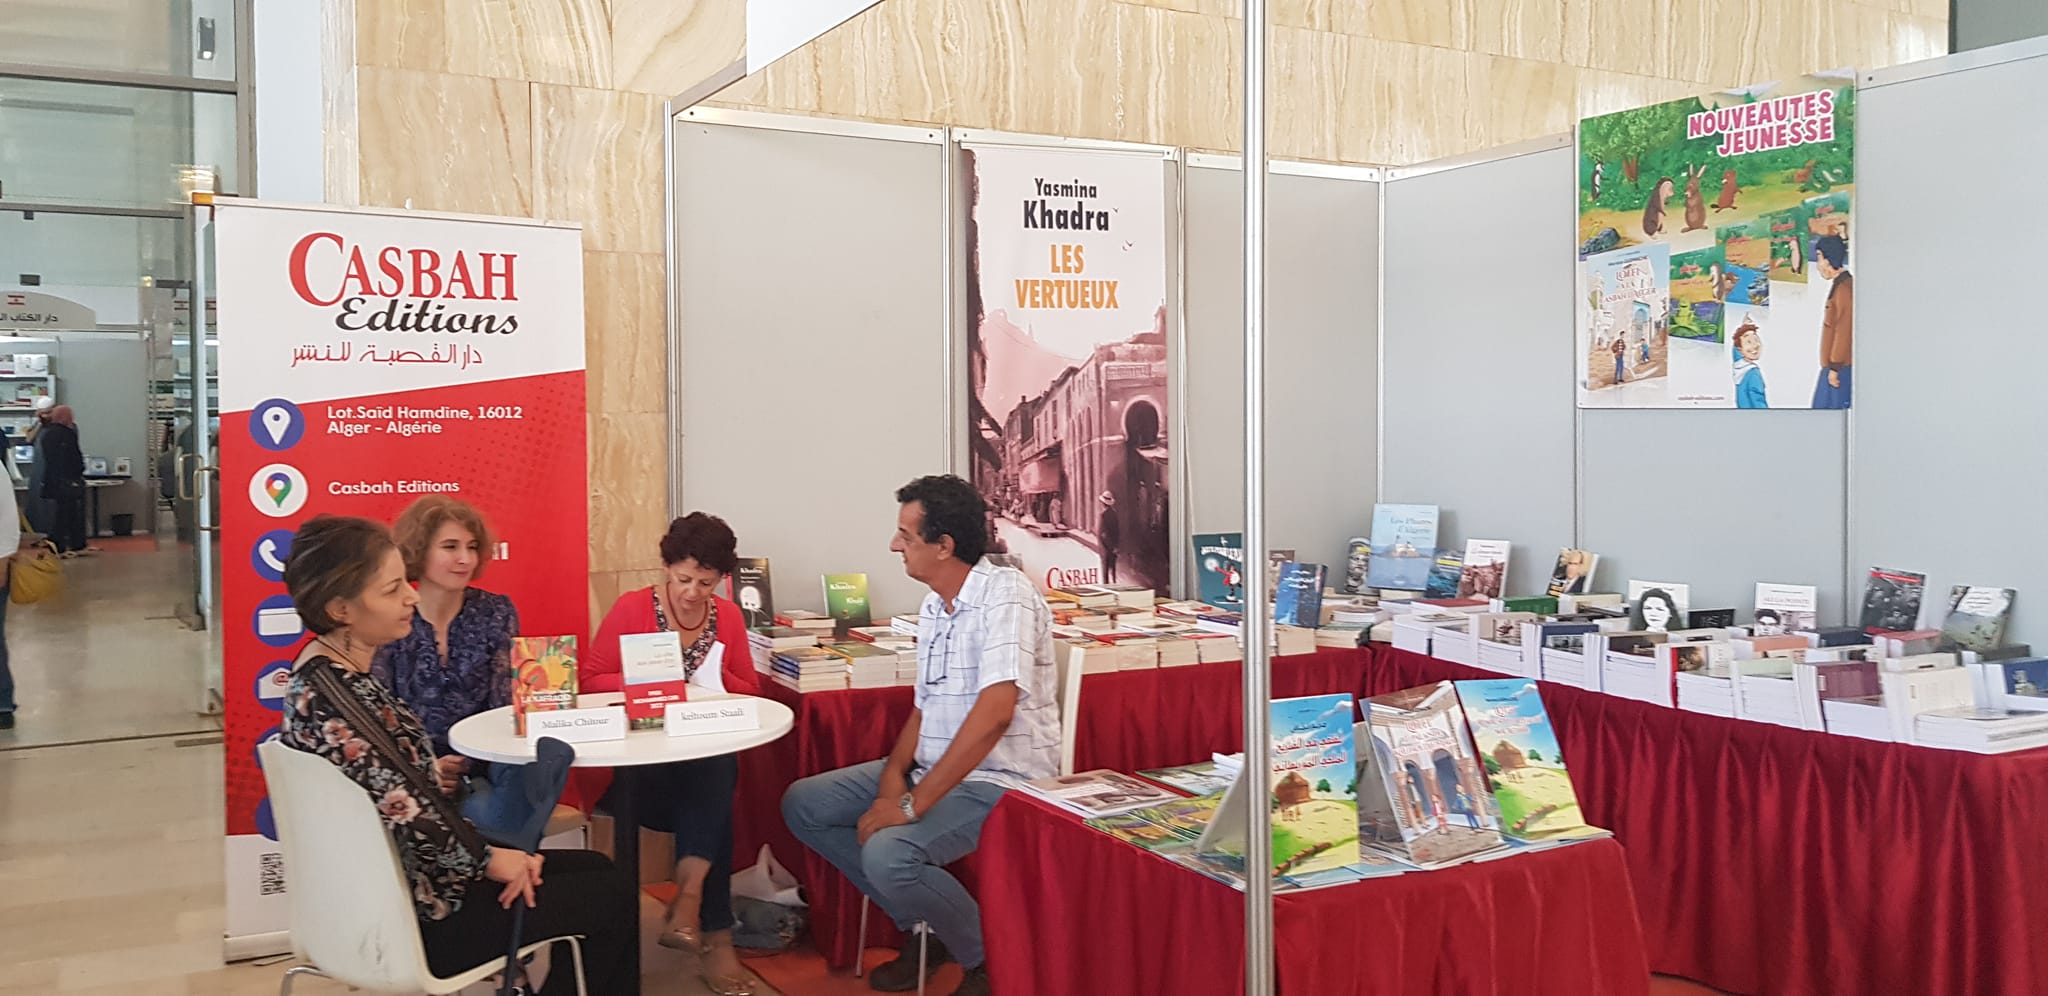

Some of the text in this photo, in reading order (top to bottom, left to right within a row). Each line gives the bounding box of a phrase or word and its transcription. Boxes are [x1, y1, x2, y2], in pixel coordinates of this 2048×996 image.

[1688, 90, 1833, 138] NOUVEAUTES
[1717, 116, 1833, 156] JEUNESSE
[1034, 178, 1097, 199] Yasmina
[1023, 199, 1110, 231] Khadra
[288, 232, 518, 306] CASBAH
[1050, 244, 1084, 274] LES
[1015, 279, 1120, 309] VERTUEUX
[43, 313, 59, 325] دار
[335, 297, 518, 334] Editions
[291, 341, 483, 370] دار القصبة للنشر
[477, 406, 523, 419] 16012
[327, 421, 371, 437] Alger
[386, 421, 442, 437] Algérie
[328, 480, 460, 495] Casbah Editions
[1046, 567, 1098, 588] CASBAH
